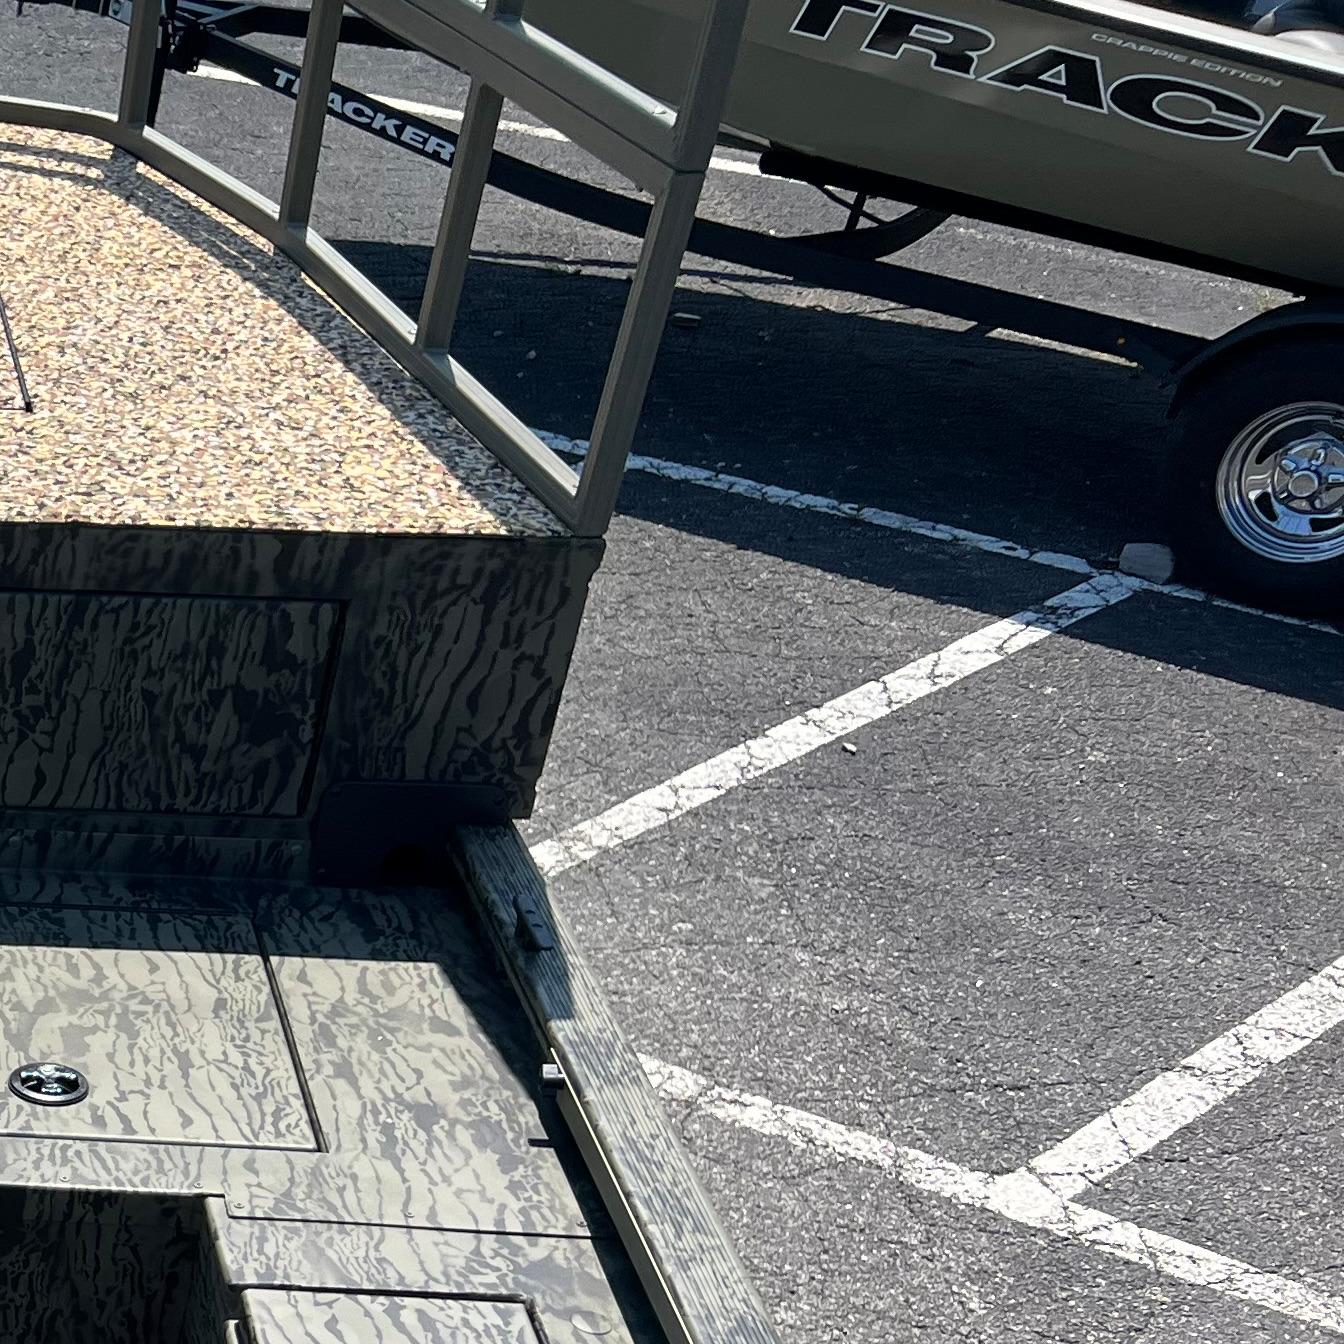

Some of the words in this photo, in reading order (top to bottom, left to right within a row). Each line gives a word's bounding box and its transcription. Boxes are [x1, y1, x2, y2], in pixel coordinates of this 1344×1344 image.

[1090, 33, 1188, 63] CRAPPIE
[1189, 58, 1284, 88] EDITION
[273, 67, 456, 161] TACKER
